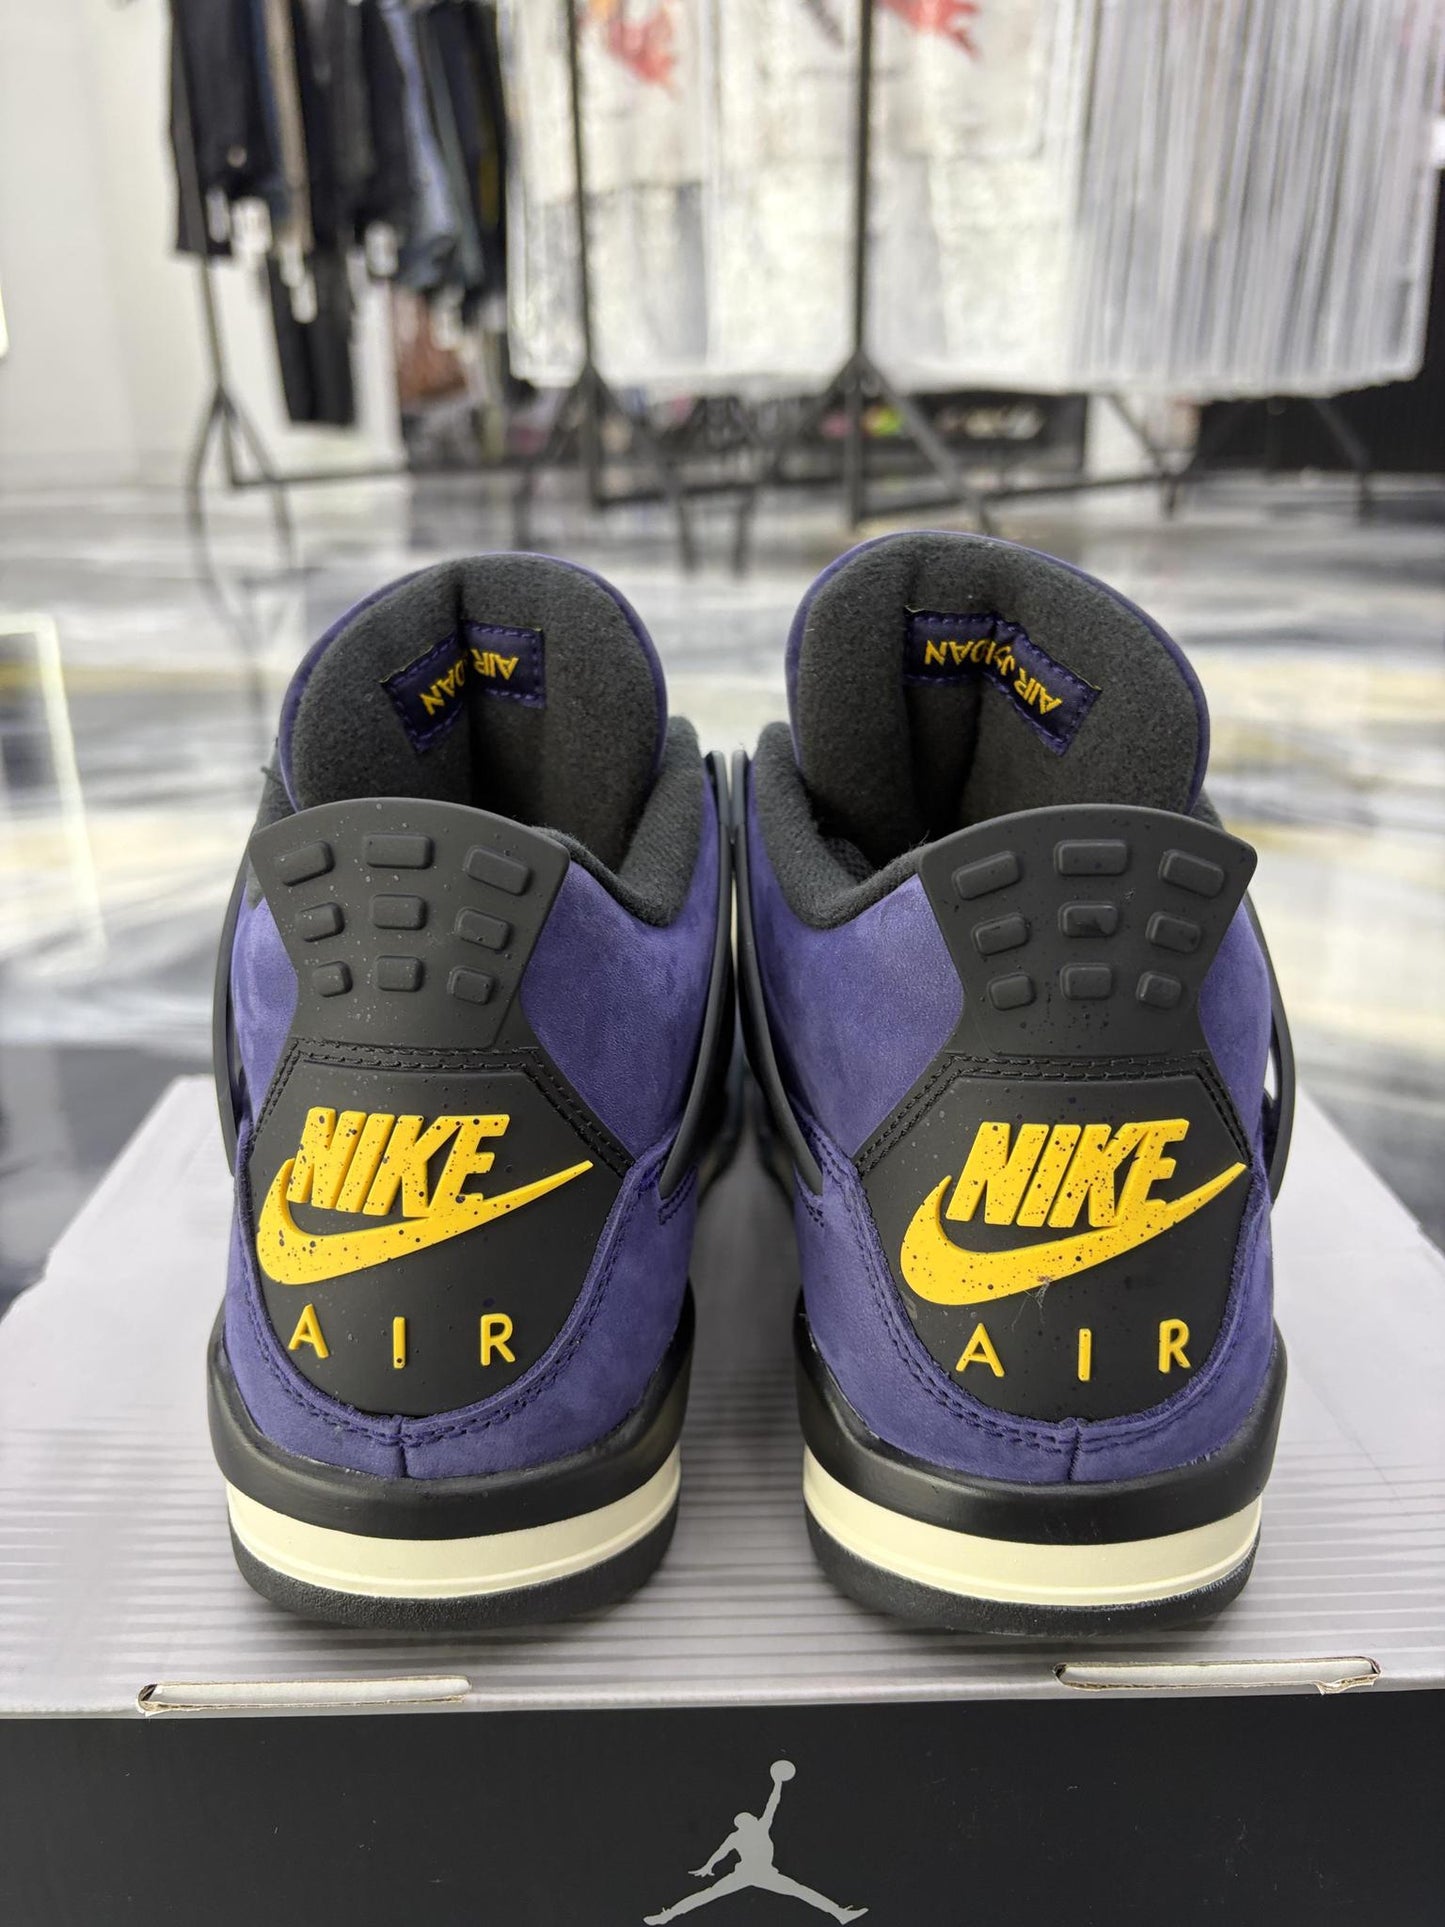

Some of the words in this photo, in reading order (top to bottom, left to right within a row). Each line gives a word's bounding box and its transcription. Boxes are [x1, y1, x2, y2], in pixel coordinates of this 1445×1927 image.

[419, 658, 468, 716] DAN
[471, 647, 518, 680] AIR
[1013, 667, 1063, 715] AIR
[286, 1106, 511, 1218] NIKE
[945, 1117, 1190, 1228] NIKE
[287, 1303, 516, 1370] AIR
[955, 1318, 1191, 1382] AIR
